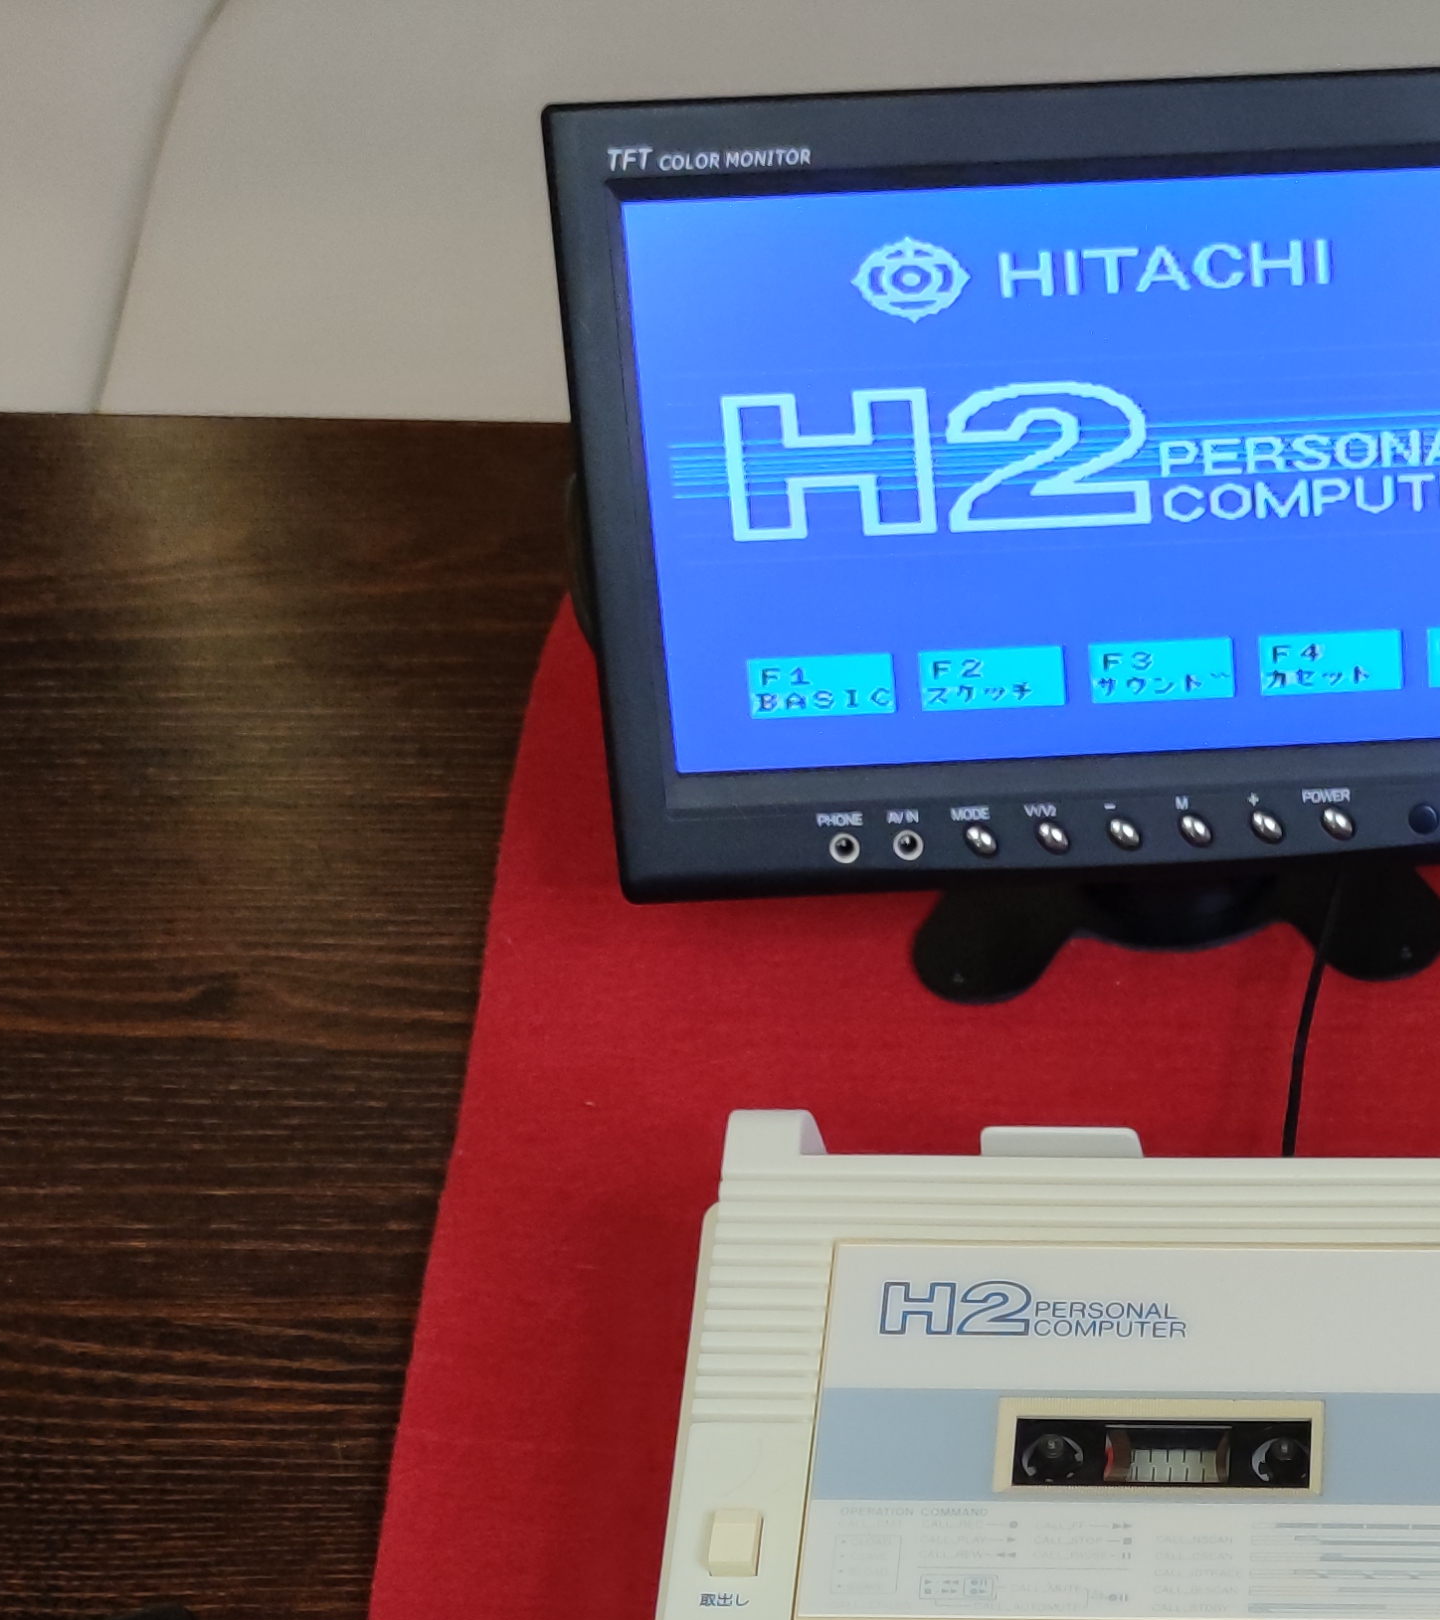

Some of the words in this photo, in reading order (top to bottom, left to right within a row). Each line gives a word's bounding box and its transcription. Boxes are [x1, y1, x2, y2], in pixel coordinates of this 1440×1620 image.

[608, 148, 653, 171] TFT
[659, 152, 720, 171] COLOR
[725, 147, 811, 168] MONITOR
[999, 238, 1332, 298] HITACHI
[720, 382, 1152, 543] H2
[756, 690, 891, 713] BASIC
[1301, 788, 1351, 803] POWER
[816, 811, 863, 827] PHONE
[950, 805, 990, 821] MODE
[879, 1281, 1032, 1336] H2
[1034, 1301, 1180, 1320] PERSONAL
[1033, 1320, 1187, 1338] COMPUTER
[840, 1507, 914, 1517] OPERATION
[921, 1507, 989, 1517] COMMAND
[699, 1593, 750, 1607] 取出し
